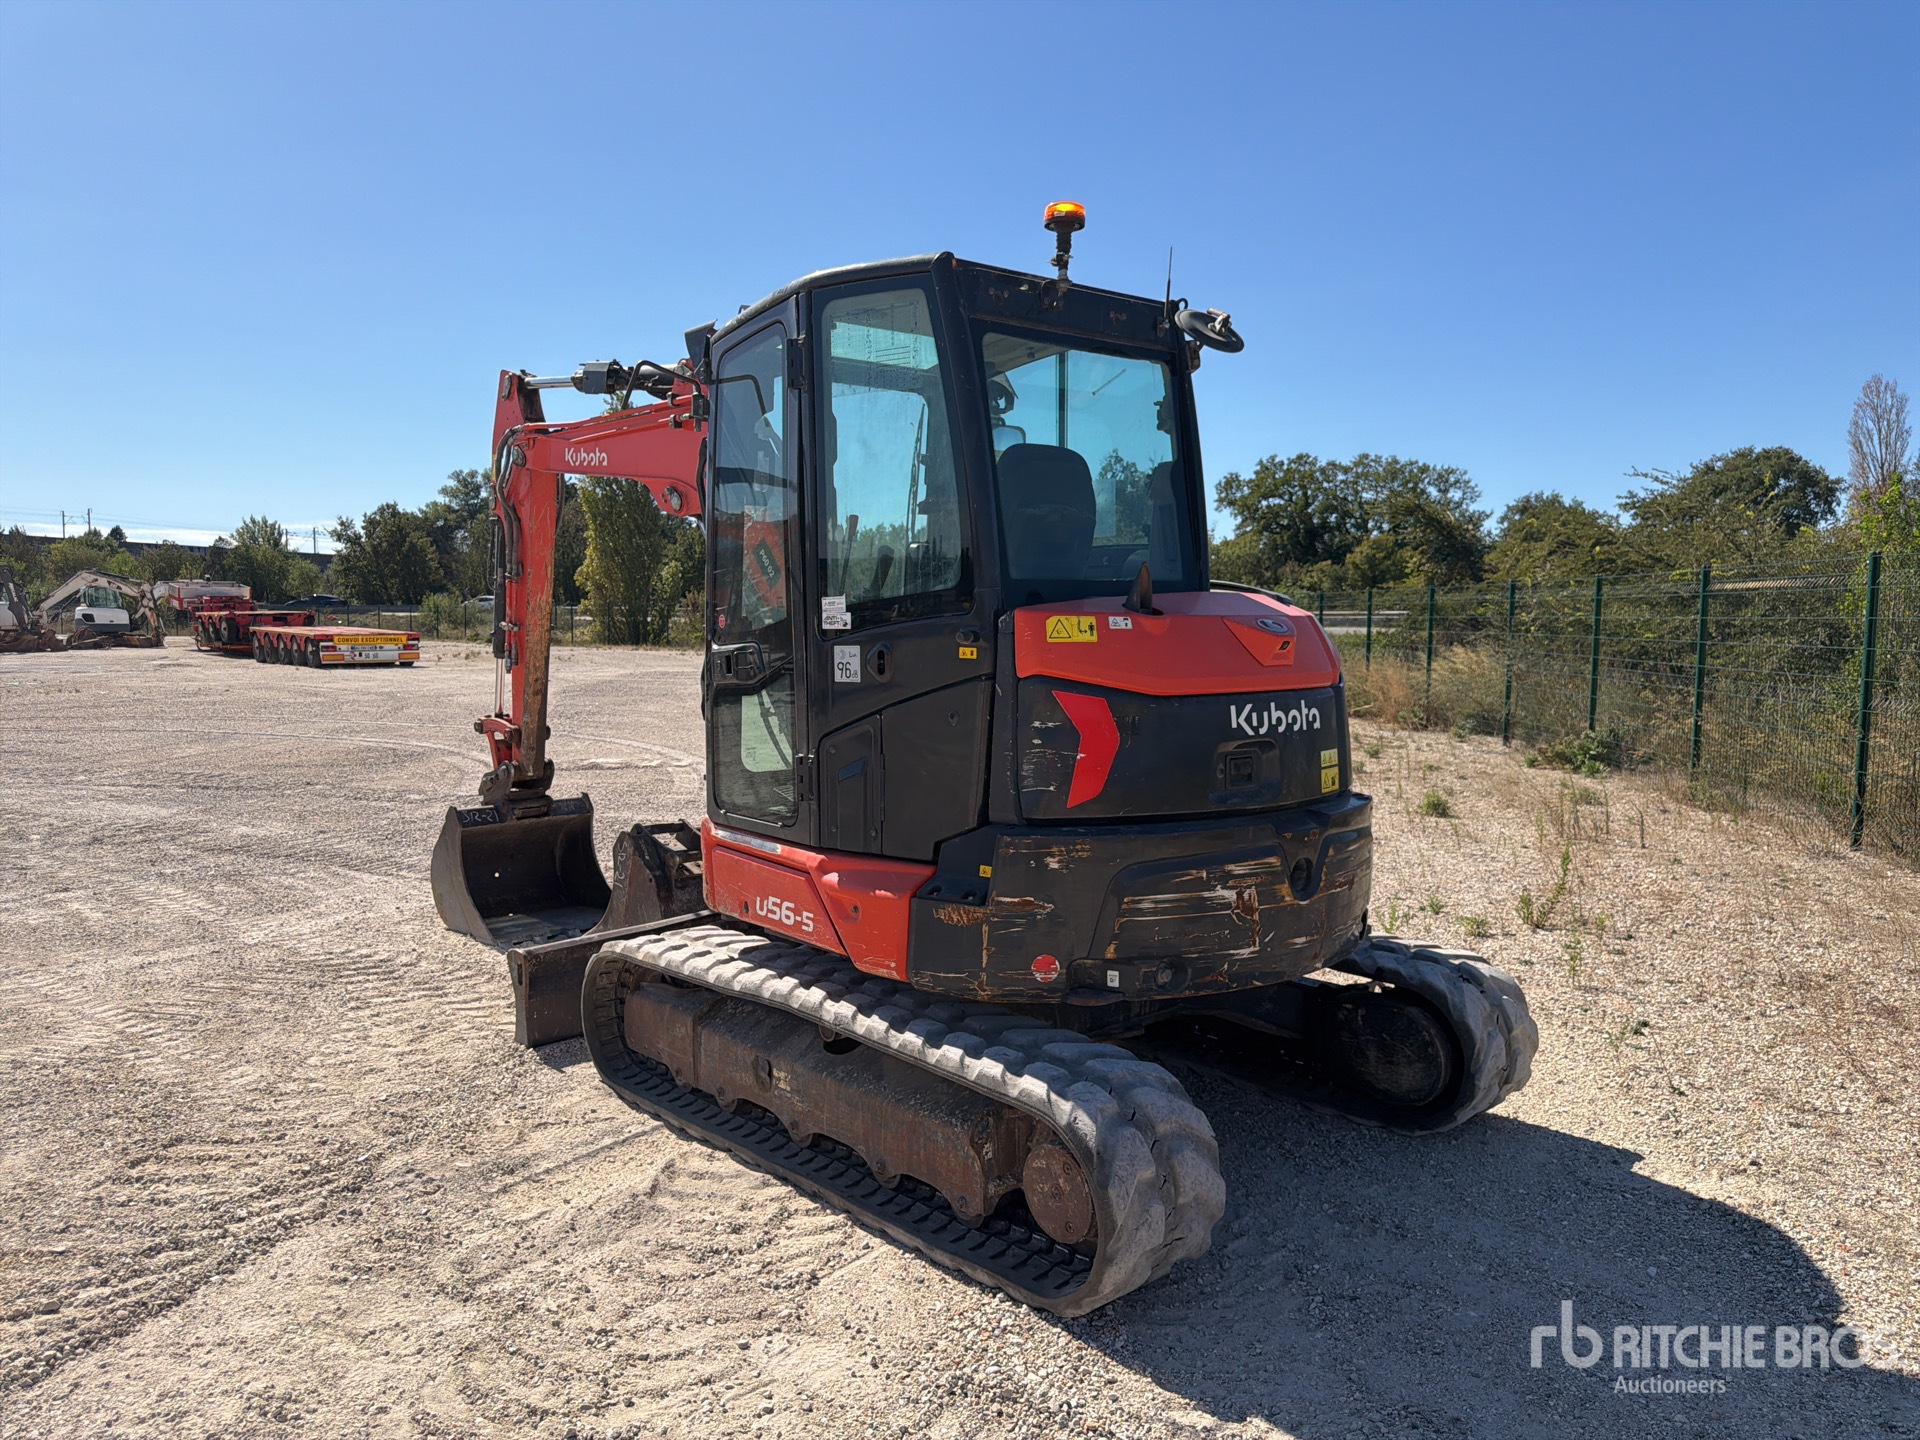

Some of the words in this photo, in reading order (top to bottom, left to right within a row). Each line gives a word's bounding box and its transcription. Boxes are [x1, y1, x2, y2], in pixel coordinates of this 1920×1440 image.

[565, 447, 608, 467] Kubota
[836, 661, 852, 679] 96
[1229, 699, 1321, 736] Kubota
[755, 895, 814, 932] U56-5
